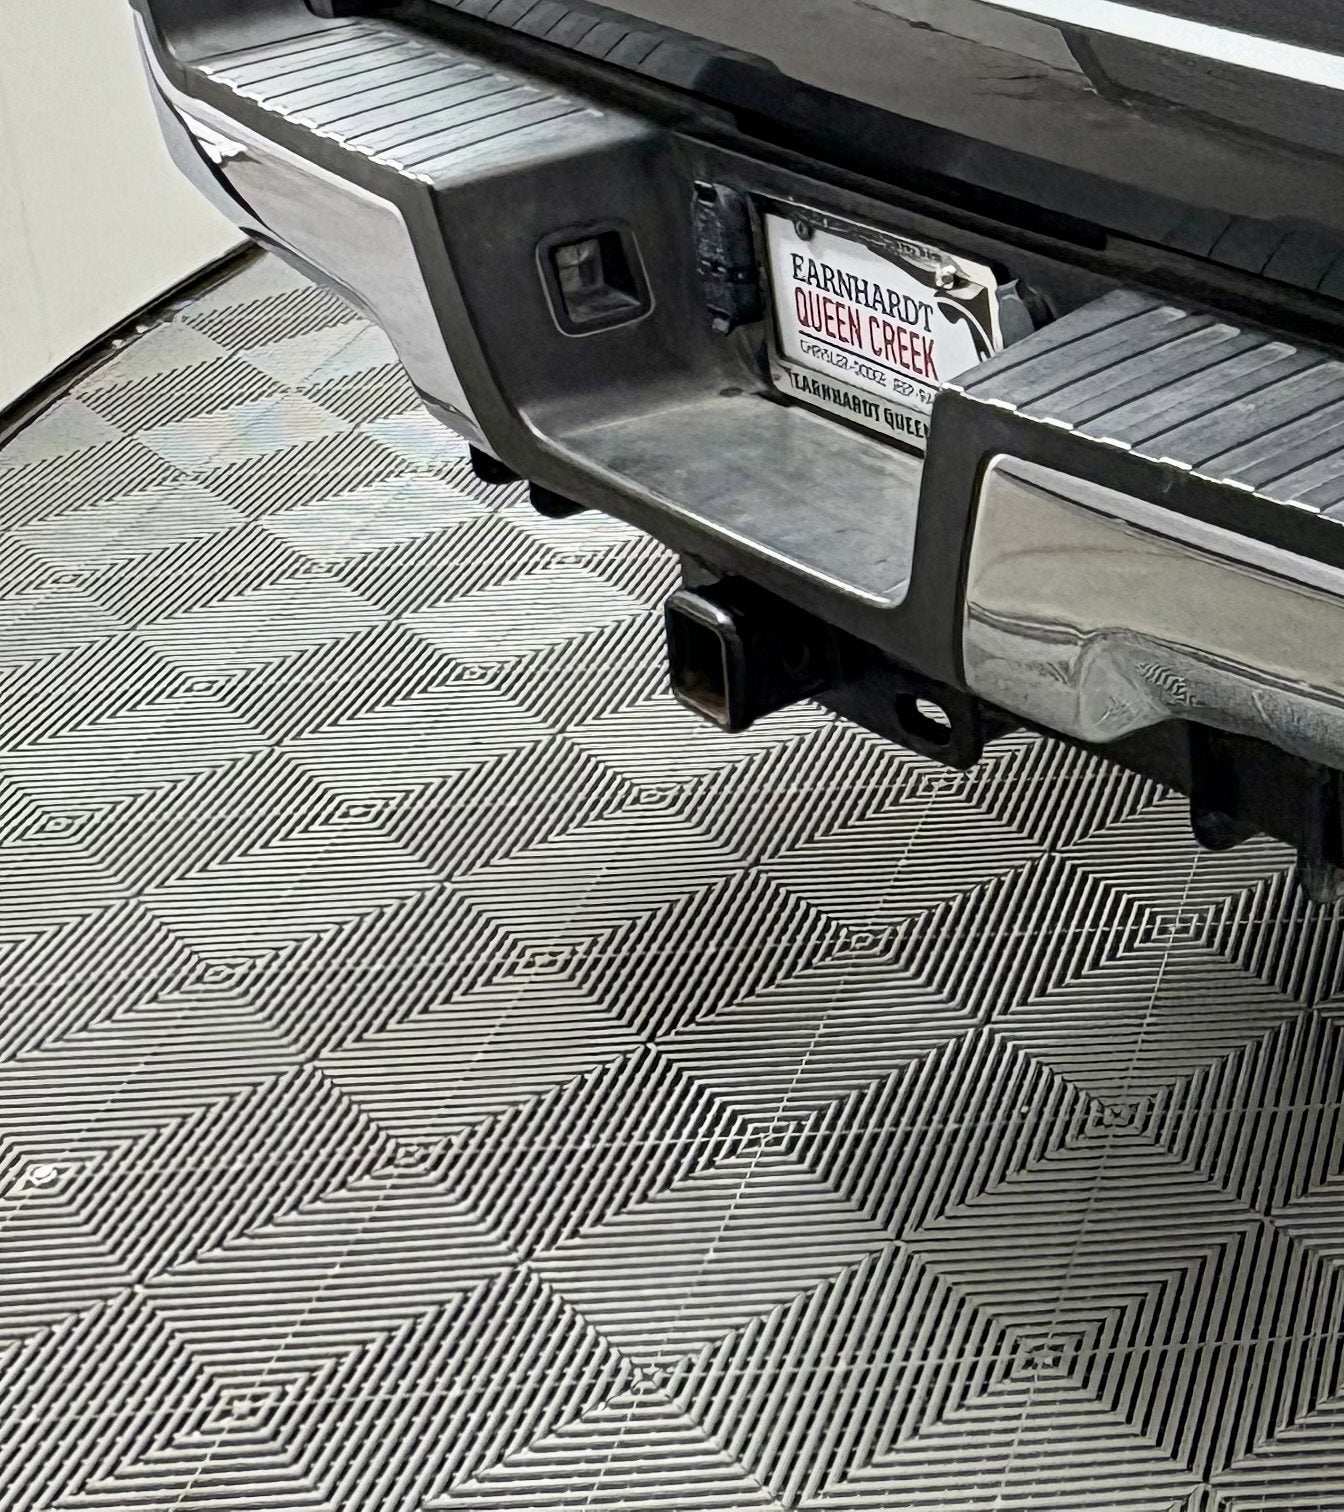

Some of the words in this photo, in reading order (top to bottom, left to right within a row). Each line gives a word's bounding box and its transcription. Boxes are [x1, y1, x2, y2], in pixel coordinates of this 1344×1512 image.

[790, 252, 933, 333] EARNHARDT
[794, 286, 862, 350] QUEEN
[869, 315, 939, 381] CREEK
